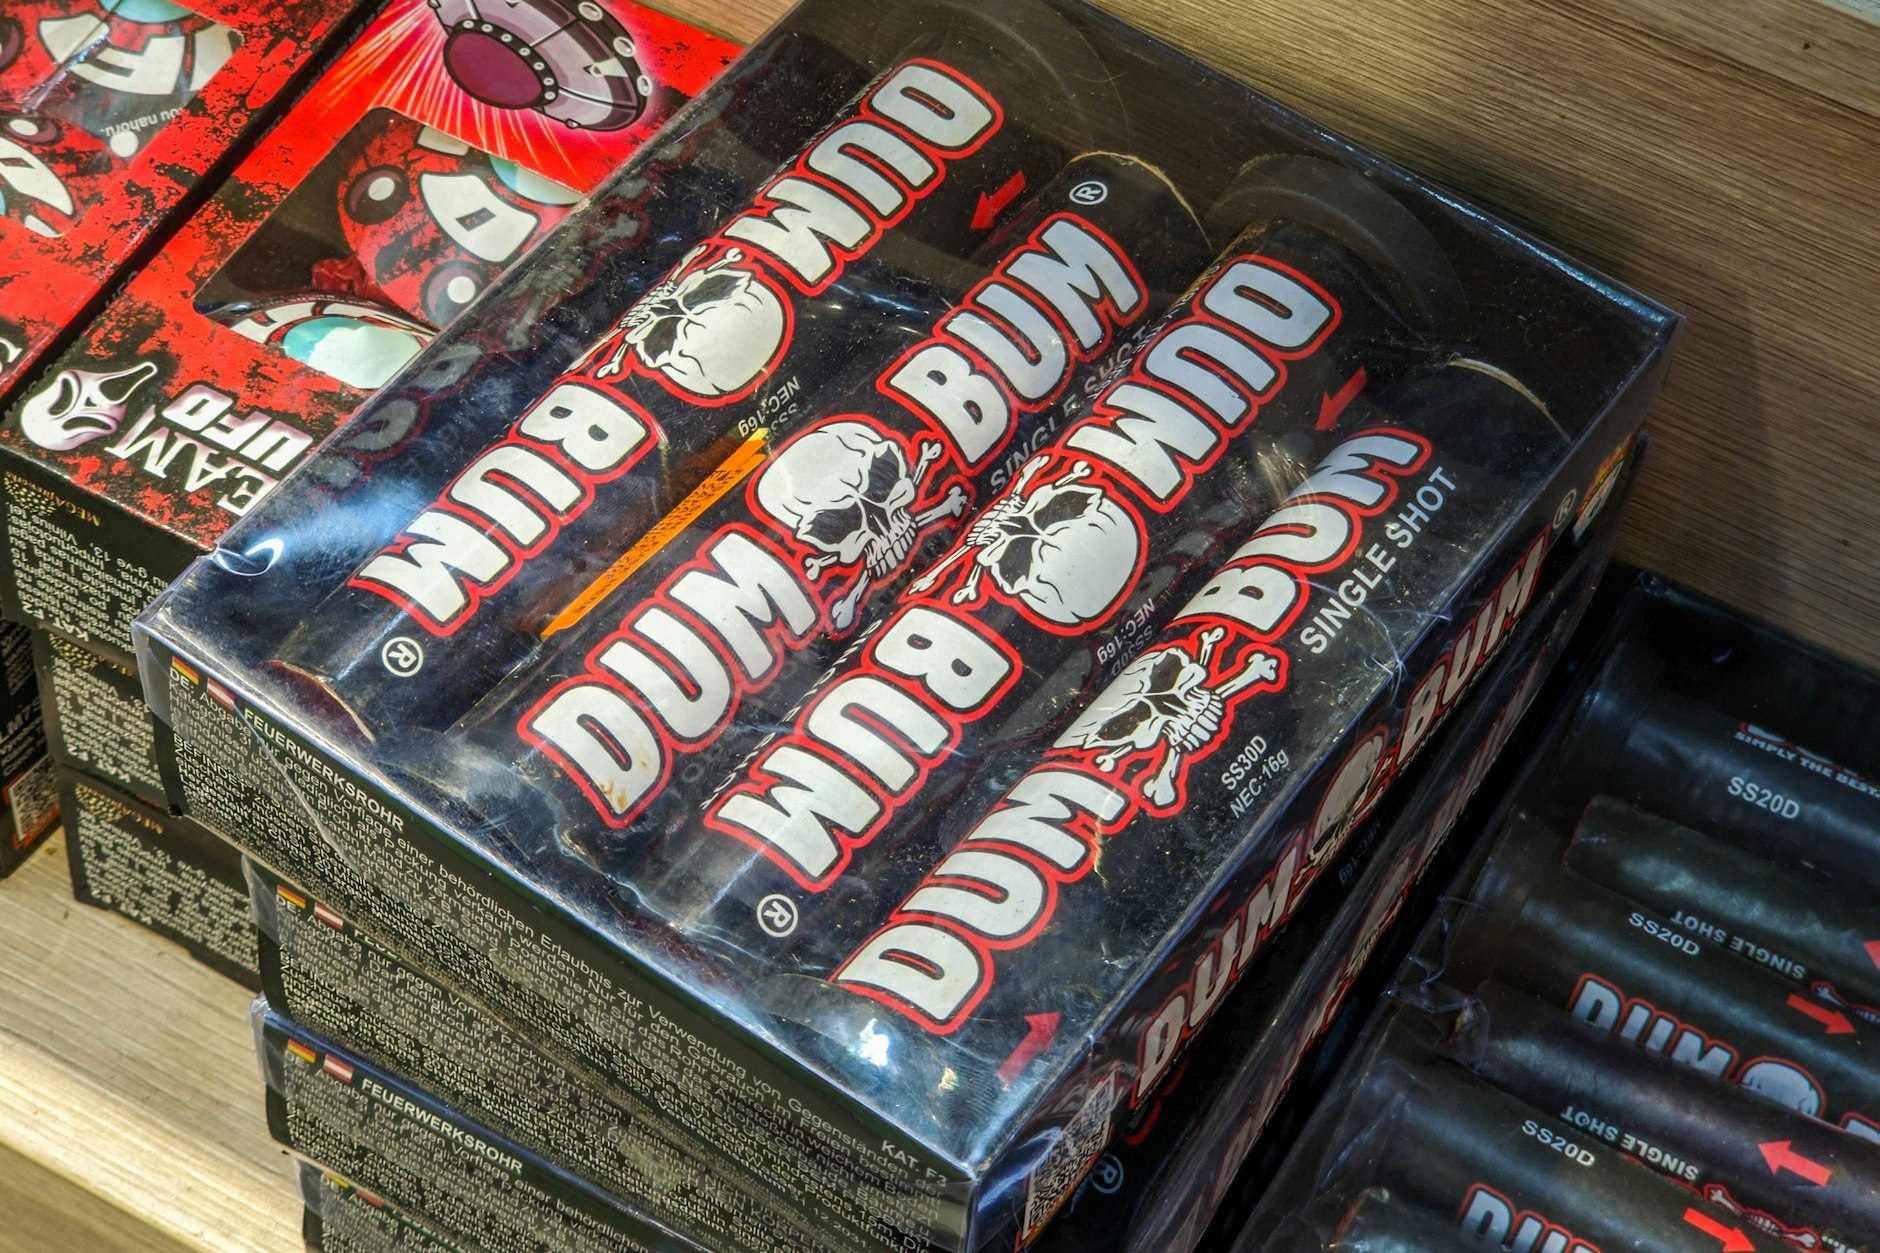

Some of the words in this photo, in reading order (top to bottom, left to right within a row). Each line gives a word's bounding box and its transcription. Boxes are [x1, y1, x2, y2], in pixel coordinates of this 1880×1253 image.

[99, 113, 157, 138] nahoru.
[725, 58, 1003, 295] DUM
[877, 213, 1149, 468] BUM
[732, 372, 804, 440] NEC:16g
[1063, 254, 1342, 512] DUM
[178, 383, 315, 472] UFO
[27, 514, 79, 545] Vilnius
[349, 383, 657, 636] BUM
[1300, 550, 1396, 655] SINGLE
[1390, 465, 1459, 549] SHOT
[17, 598, 47, 619] F2
[45, 612, 92, 641] KAT.
[1091, 595, 1158, 666] NEC:16g
[518, 522, 818, 828] DUM
[705, 600, 1022, 892] BUM
[833, 762, 1134, 1033] DUM
[1164, 426, 1433, 643] BUM
[1220, 734, 1269, 792] SS30D
[1733, 729, 1797, 763] SIMPLY
[1797, 756, 1834, 778] THE
[243, 706, 404, 834] FEUERWERKSROHR
[1228, 748, 1290, 820] NEC:16g
[1726, 775, 1801, 822] SS20D
[1130, 845, 1302, 1110] DUM
[1396, 526, 1550, 764] BUM
[168, 679, 233, 737] Kategorie
[293, 771, 351, 824] lediglich
[356, 818, 377, 840] als
[383, 836, 447, 892] Packung
[453, 886, 513, 936] verkauft
[519, 930, 579, 981] werden.
[587, 976, 616, 1006] Nur
[622, 999, 644, 1024] für
[649, 1017, 679, 1048] den
[687, 1042, 764, 1103] Gebrauch
[772, 1098, 791, 1120] im
[799, 1115, 851, 1159] Freien
[168, 665, 195, 696] DE:
[198, 688, 251, 741] Abgabe
[284, 751, 329, 797] gegen
[333, 787, 392, 842] Vorflage
[396, 832, 434, 871] einer
[438, 862, 534, 938] behördlichen
[539, 931, 612, 991] Erlaubnis
[616, 982, 643, 1012] zur
[648, 1003, 747, 1082] Verwendung
[752, 1072, 781, 1102] von
[788, 1094, 908, 1184] Gegenständen
[915, 1174, 943, 1201] der
[1628, 911, 1701, 957] SS20D
[1670, 908, 1727, 948] SHOT
[1730, 930, 1807, 980] SINGLE
[168, 690, 249, 757] Hindernisse
[250, 748, 281, 780] über
[316, 798, 371, 847] Produkt
[373, 840, 403, 870] sind
[405, 861, 423, 884] zu
[425, 876, 505, 942] vermeiden.
[509, 935, 607, 1011] Positionieren
[611, 1004, 635, 1030] Sie
[637, 1022, 665, 1050] das
[669, 1043, 707, 1078] Rohr
[710, 1069, 789, 1131] senkrecht
[790, 1122, 804, 1140] in
[807, 1132, 880, 1187] weichem
[884, 1178, 938, 1221] Boden
[306, 912, 362, 955] Abgabe
[367, 948, 390, 969] nur
[397, 964, 442, 1000] gegen
[406, 979, 464, 1023] lediglich
[472, 1018, 493, 1038] als
[412, 889, 459, 932] Kappe
[461, 924, 486, 948] der
[583, 1006, 634, 1050] NICHT
[652, 1053, 679, 1080] der
[681, 1073, 723, 1109] Nähe
[726, 1102, 771, 1141] hoher
[500, 1031, 565, 1081] Packung
[507, 945, 557, 987] Stellen
[562, 983, 584, 1006] sie
[641, 1037, 678, 1069] dass
[683, 1064, 711, 1091] das
[714, 1085, 812, 1156] Ausstoßrohr
[816, 1150, 855, 1183] nicht
[361, 1078, 524, 1175] FEUERWERKSROHR
[679, 1091, 709, 1119] sich
[714, 1114, 757, 1151] sofort
[762, 1146, 853, 1213] mindestens
[1521, 1120, 1595, 1167] SS20D
[1559, 1104, 1617, 1141] SHOT
[1620, 1132, 1699, 1181] SINGLE
[770, 1160, 796, 1185] der
[881, 1136, 918, 1172] KAT.
[925, 1164, 946, 1190] F3
